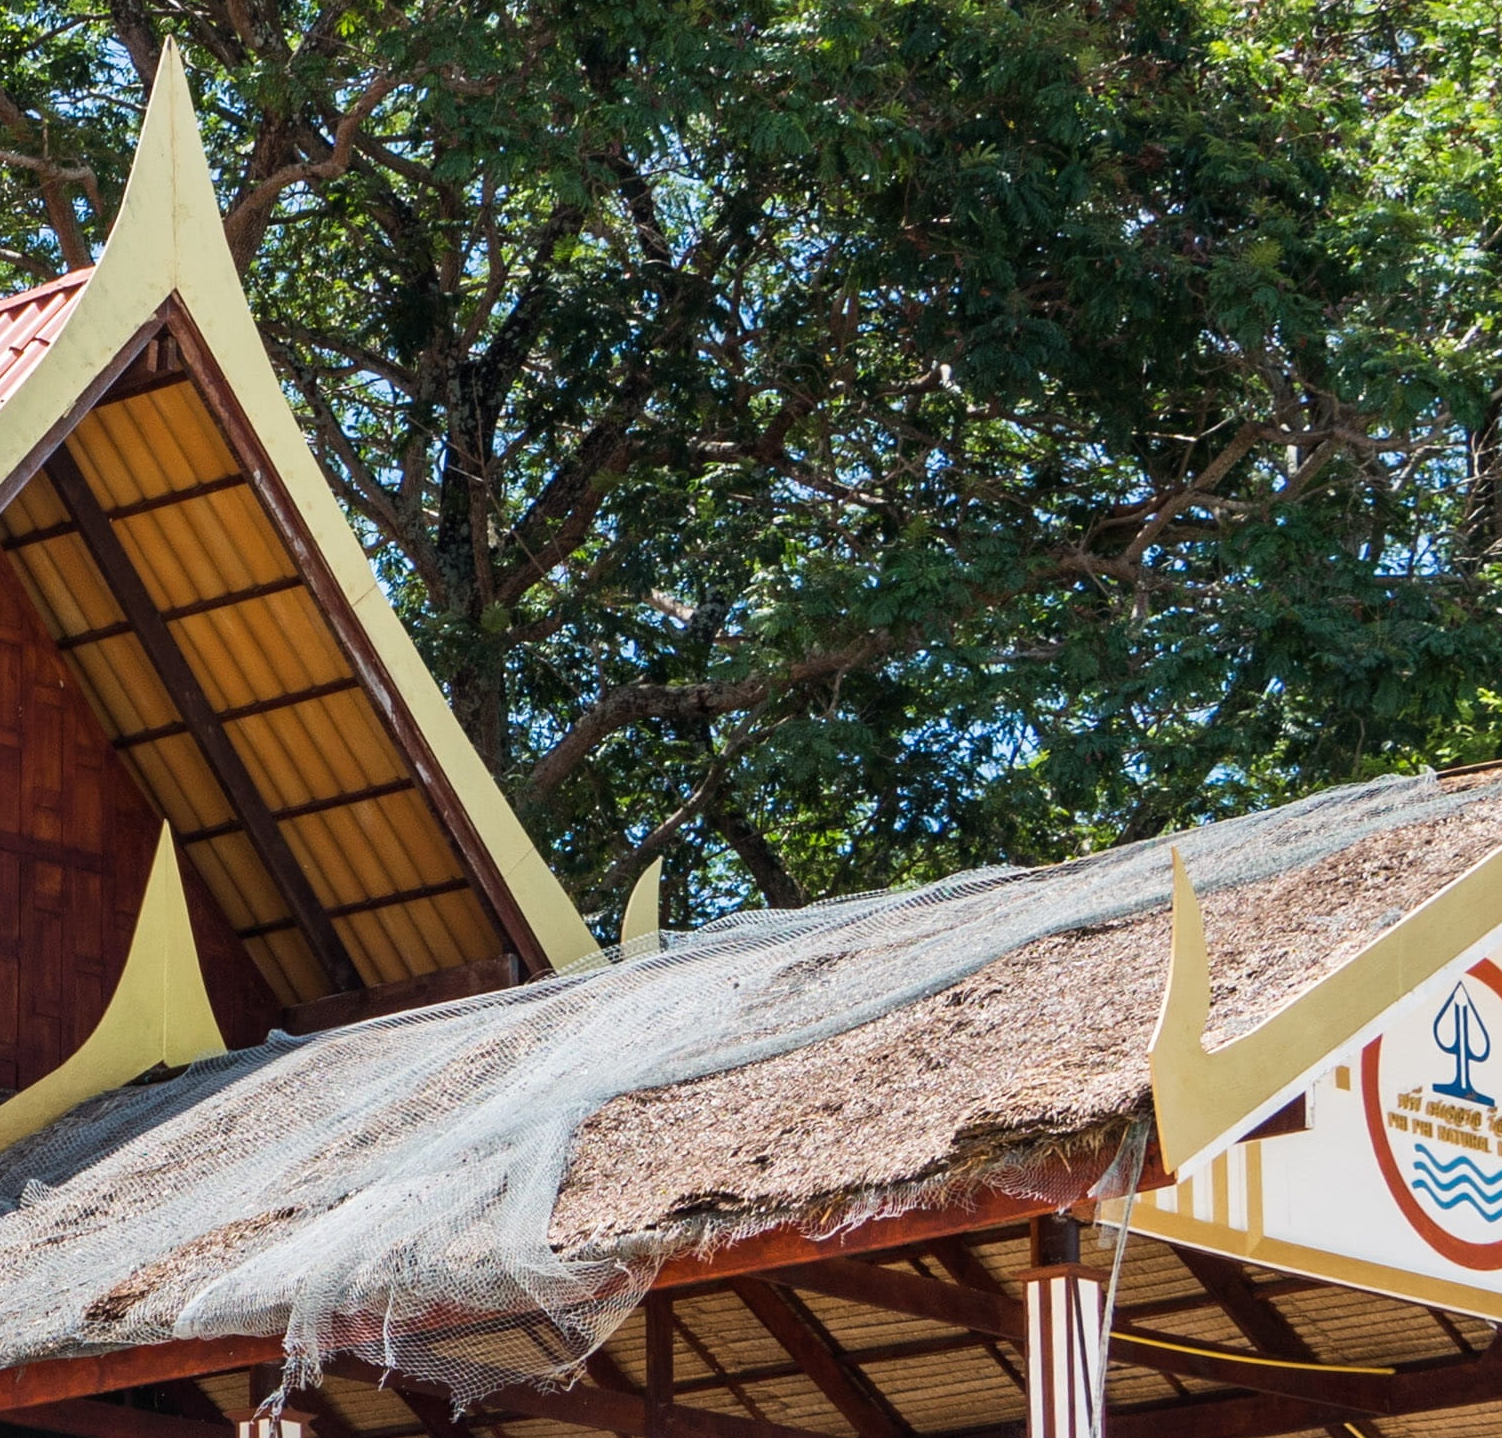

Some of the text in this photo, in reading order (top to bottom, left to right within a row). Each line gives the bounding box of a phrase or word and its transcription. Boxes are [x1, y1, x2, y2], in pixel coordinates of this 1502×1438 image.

[1388, 1111, 1408, 1132] PHI
[1412, 1118, 1433, 1138] PHI
[1437, 1125, 1492, 1153] NATURAL
